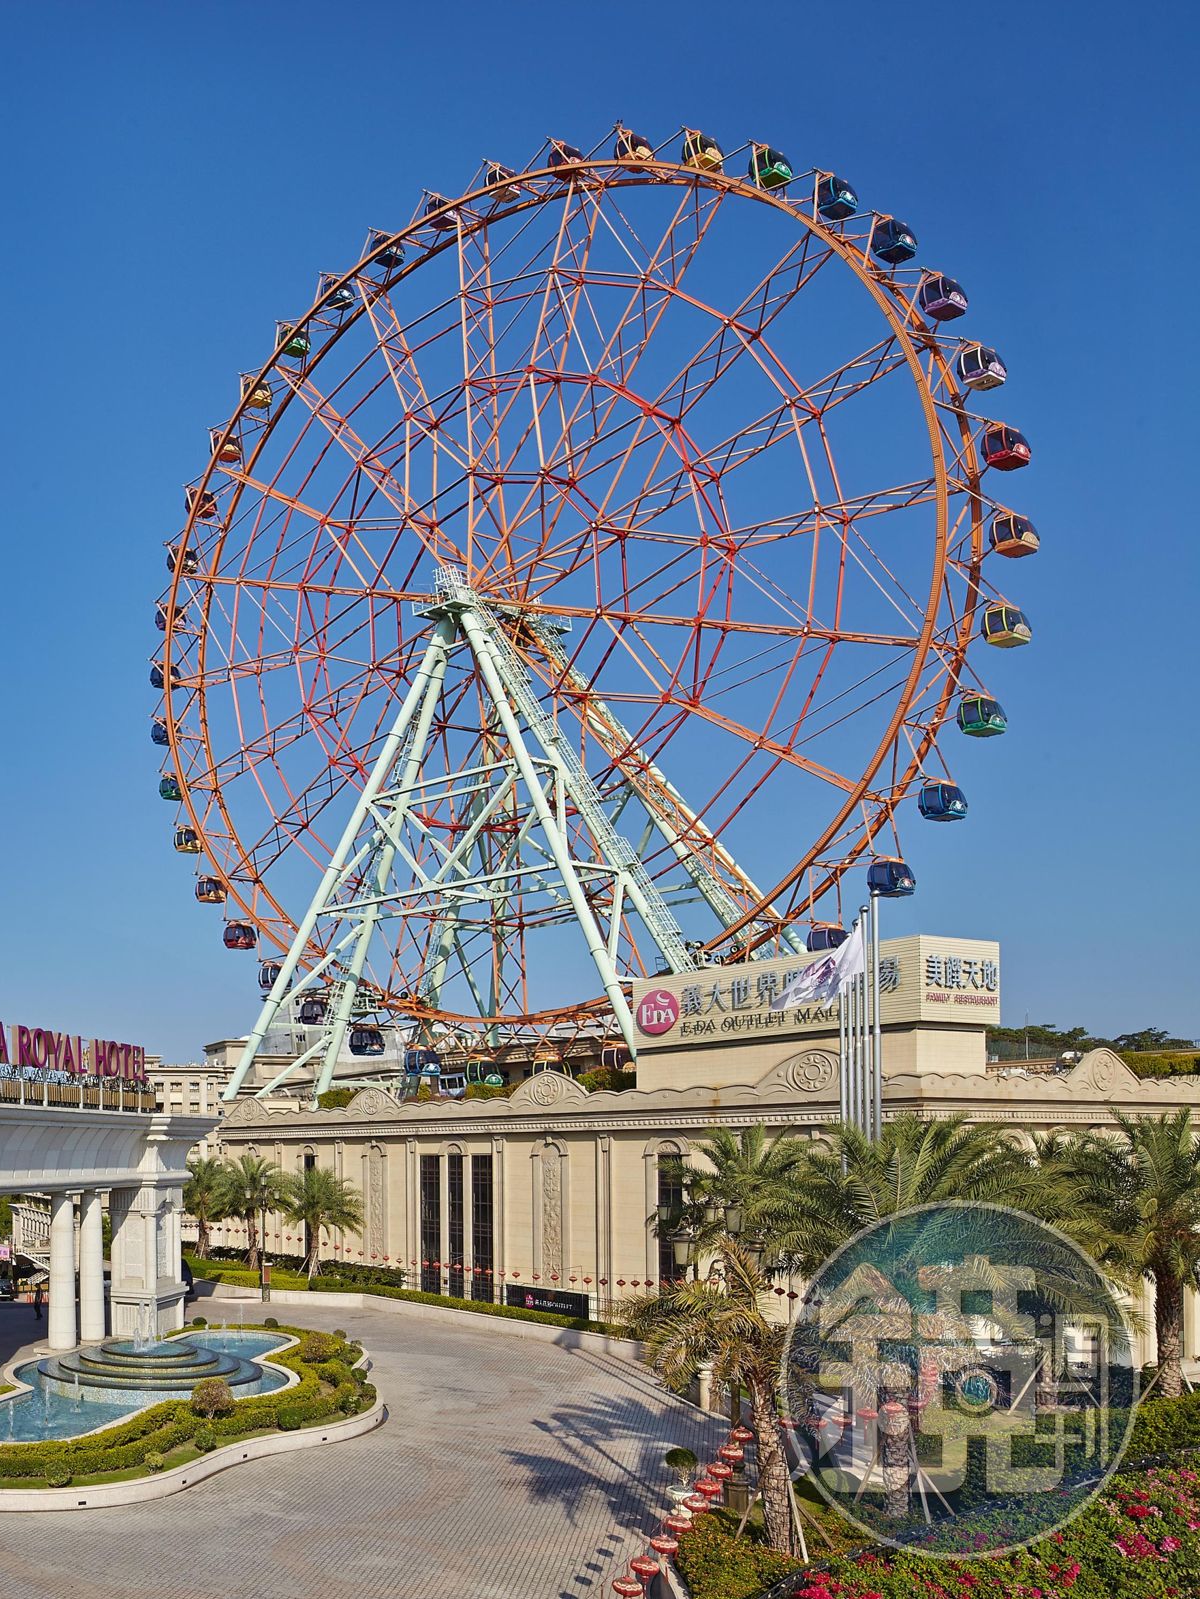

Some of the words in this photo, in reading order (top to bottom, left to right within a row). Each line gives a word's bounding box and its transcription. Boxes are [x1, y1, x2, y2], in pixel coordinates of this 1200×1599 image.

[680, 955, 902, 1018] 義大世界場
[926, 992, 951, 1004] FAMILY
[641, 1003, 676, 1027] EDA
[723, 1010, 789, 1028] OUTLET
[795, 1004, 840, 1021] MAL
[12, 1024, 87, 1074] ROYAL
[89, 1038, 150, 1082] HOTEL
